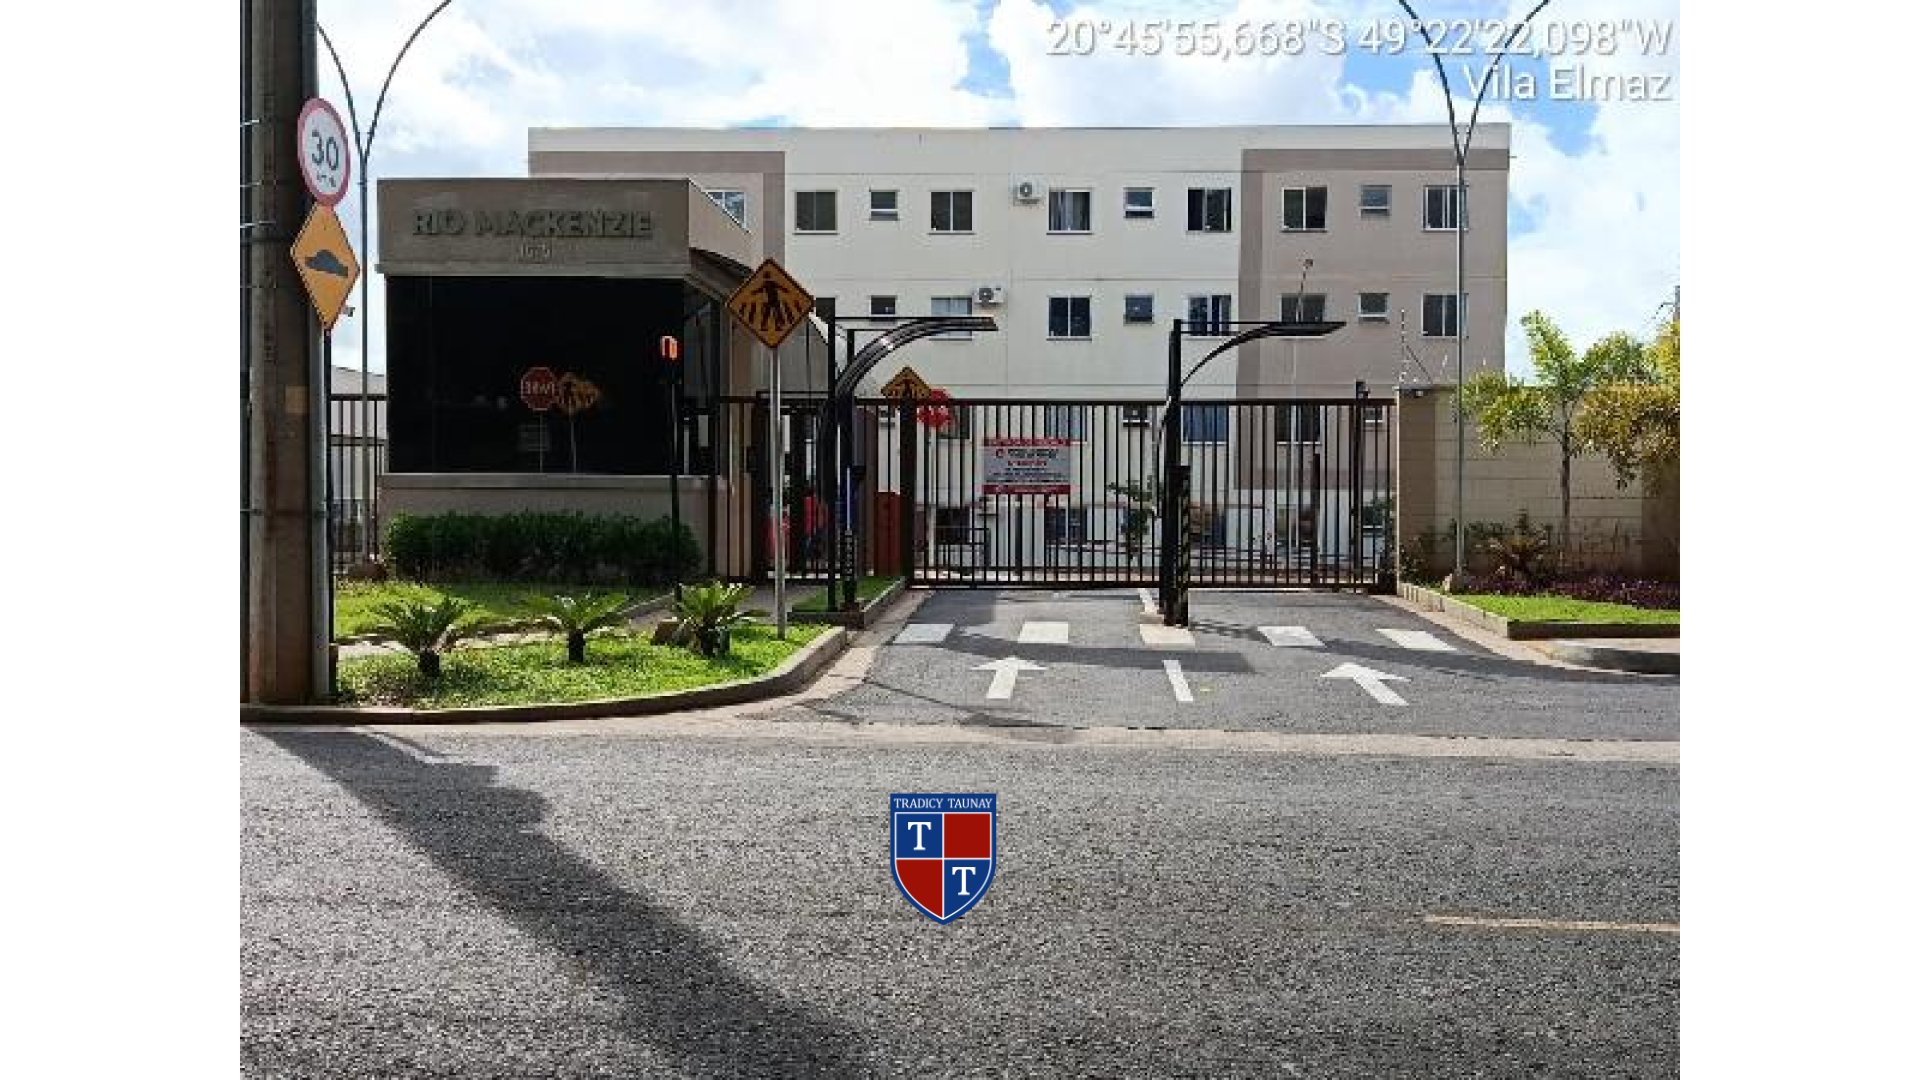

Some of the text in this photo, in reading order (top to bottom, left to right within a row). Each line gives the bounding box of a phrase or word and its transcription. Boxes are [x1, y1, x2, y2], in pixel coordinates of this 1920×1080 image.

[312, 129, 339, 171] 30
[412, 209, 654, 238] RIO MACKENZIE
